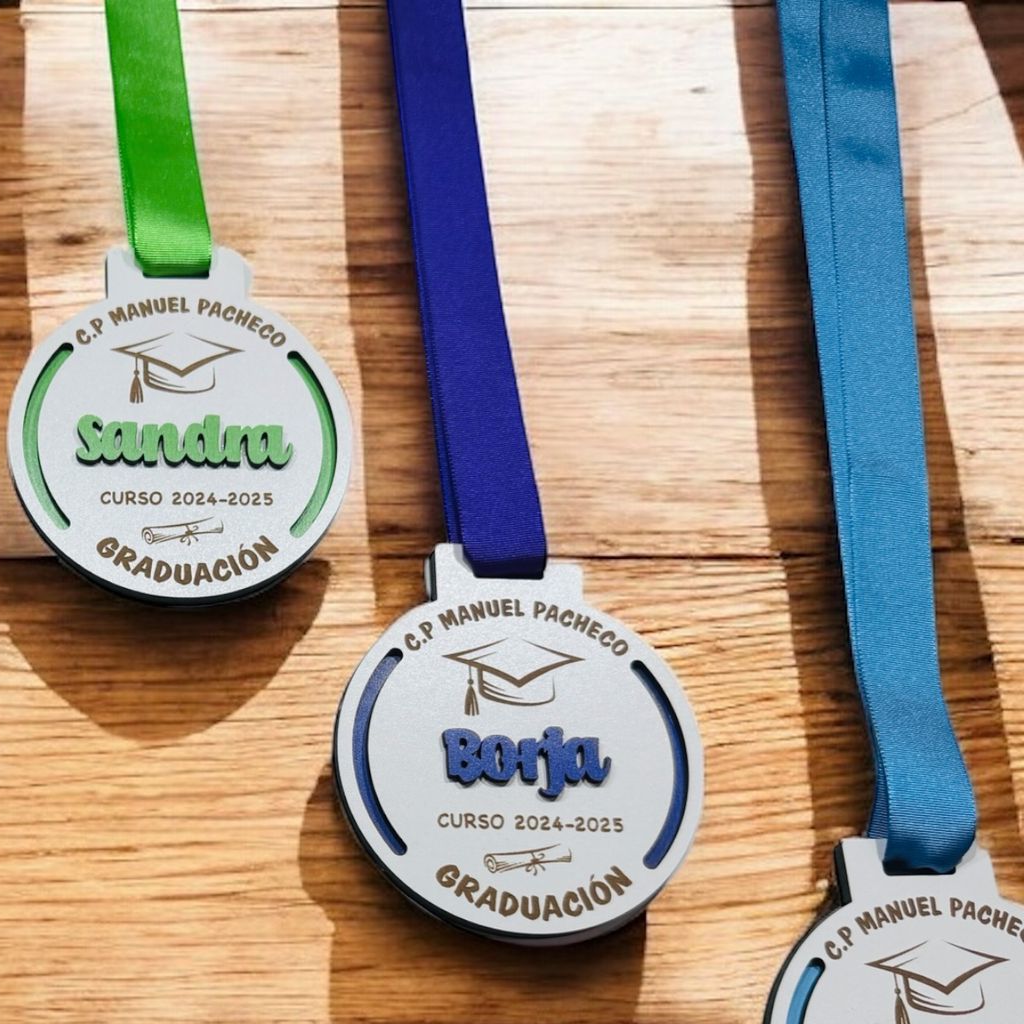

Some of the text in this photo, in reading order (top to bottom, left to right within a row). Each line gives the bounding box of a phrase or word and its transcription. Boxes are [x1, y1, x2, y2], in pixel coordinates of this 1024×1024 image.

[75, 297, 286, 348] C.P MANUEL PACHECO
[100, 490, 274, 507] CURSO 2024-2025
[95, 534, 280, 586] GRADUACIÓN
[403, 598, 629, 656] C.P MANUEL PACHECO
[441, 726, 612, 801] Borja
[436, 812, 625, 833] CURSO 2024-2025
[435, 864, 633, 922] GRADUACIÓN
[824, 896, 1024, 961] C.P MANUEL PACHE
